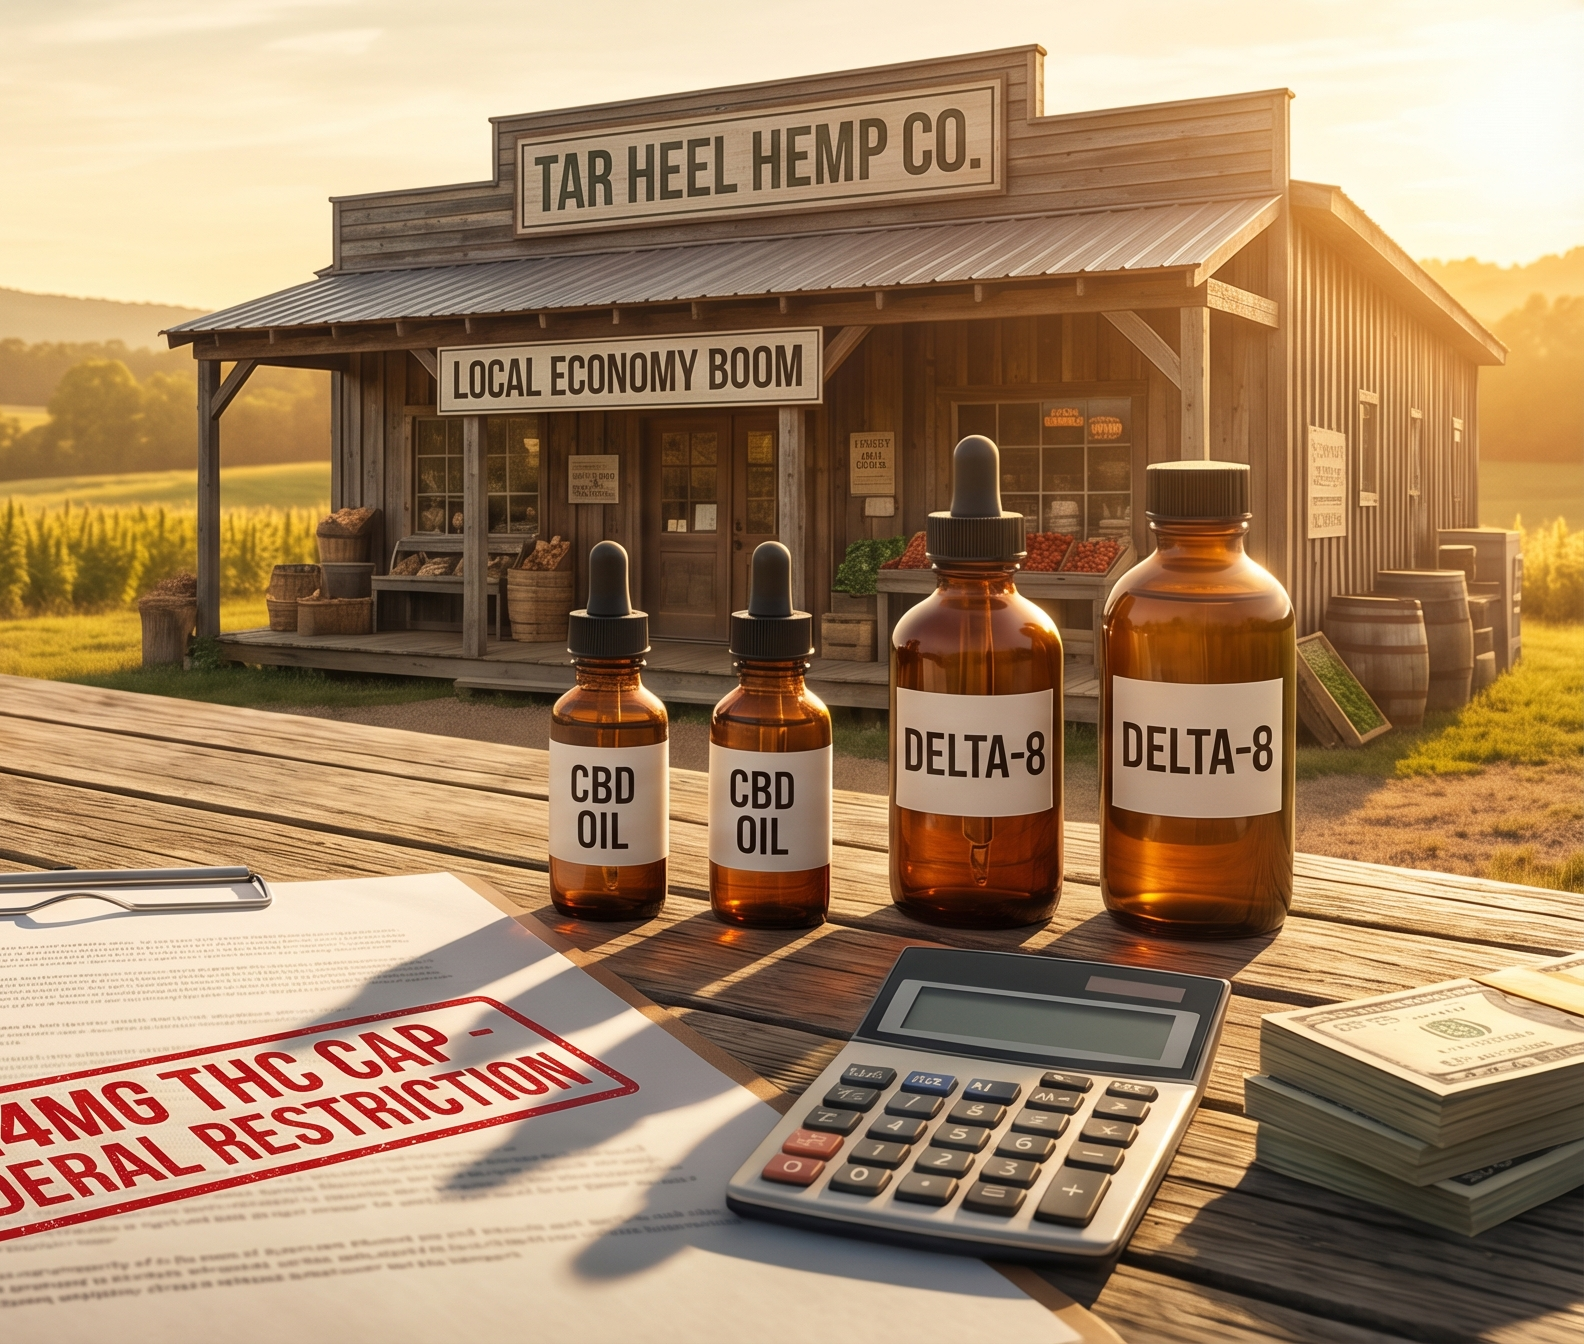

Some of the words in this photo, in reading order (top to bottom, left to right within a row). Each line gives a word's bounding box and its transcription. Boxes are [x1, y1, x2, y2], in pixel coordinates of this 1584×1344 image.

[534, 149, 614, 213] TAR
[627, 135, 738, 204] HEEL
[752, 117, 889, 192] HEMP
[902, 107, 982, 177] CO.
[453, 356, 542, 400] LOCAL
[550, 348, 699, 397] ECONOMY
[708, 343, 803, 391] BOOM
[904, 726, 1046, 779] DELTA-8
[1123, 720, 1274, 776] DELTA-8
[570, 763, 635, 804] CBD
[730, 768, 795, 810] CBD
[577, 809, 629, 849] OIL
[736, 814, 789, 855] OIL
[157, 1051, 324, 1112] THC
[313, 1022, 452, 1079] CAP
[188, 1051, 594, 1167] RESTRICTION
[887, 1120, 904, 1131] 4
[966, 1105, 985, 1116] 8
[872, 1144, 885, 1156] 1
[949, 1128, 969, 1140] 5
[1015, 1137, 1032, 1150] 6
[850, 1167, 869, 1181] 0
[933, 1153, 953, 1166] 2
[998, 1161, 1018, 1176] 3
